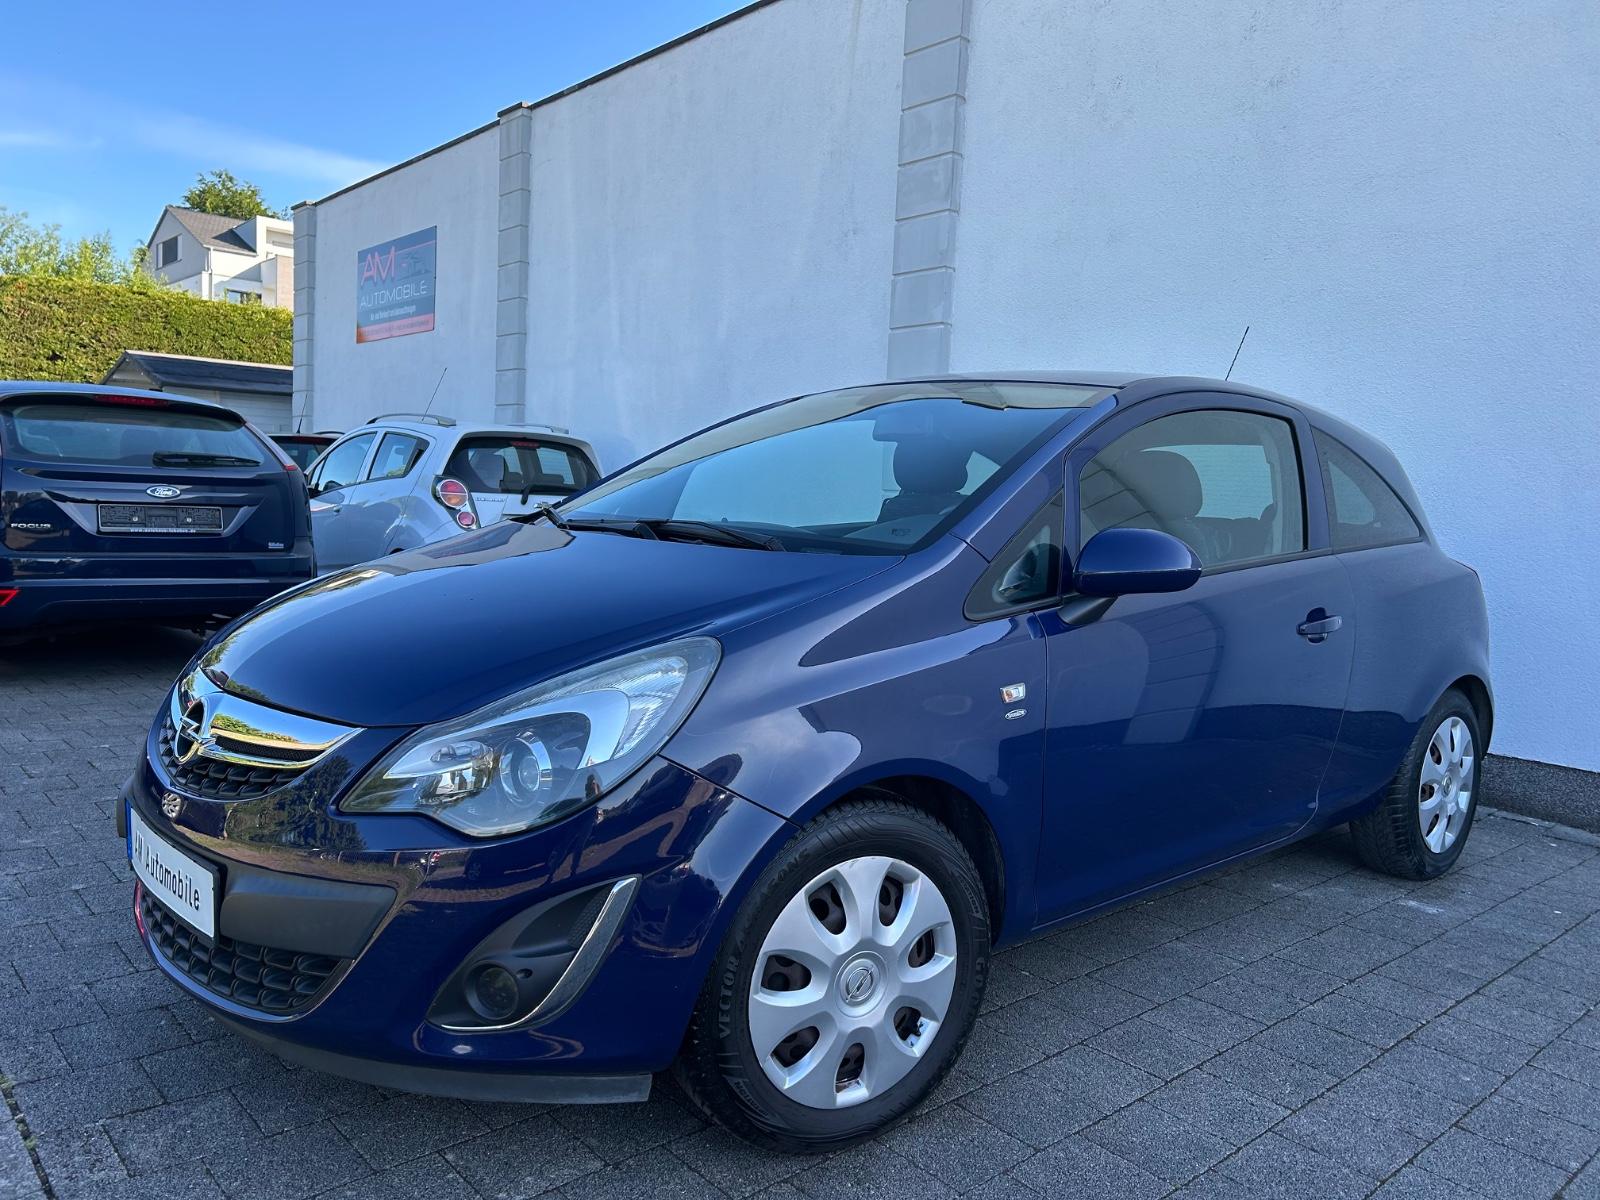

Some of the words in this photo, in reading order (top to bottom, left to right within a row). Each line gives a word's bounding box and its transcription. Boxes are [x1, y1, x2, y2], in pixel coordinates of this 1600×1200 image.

[360, 245, 396, 287] AM
[360, 280, 428, 308] AUTOMOBILE
[145, 845, 200, 911] Automobile
[718, 954, 740, 1040] VECTOR
